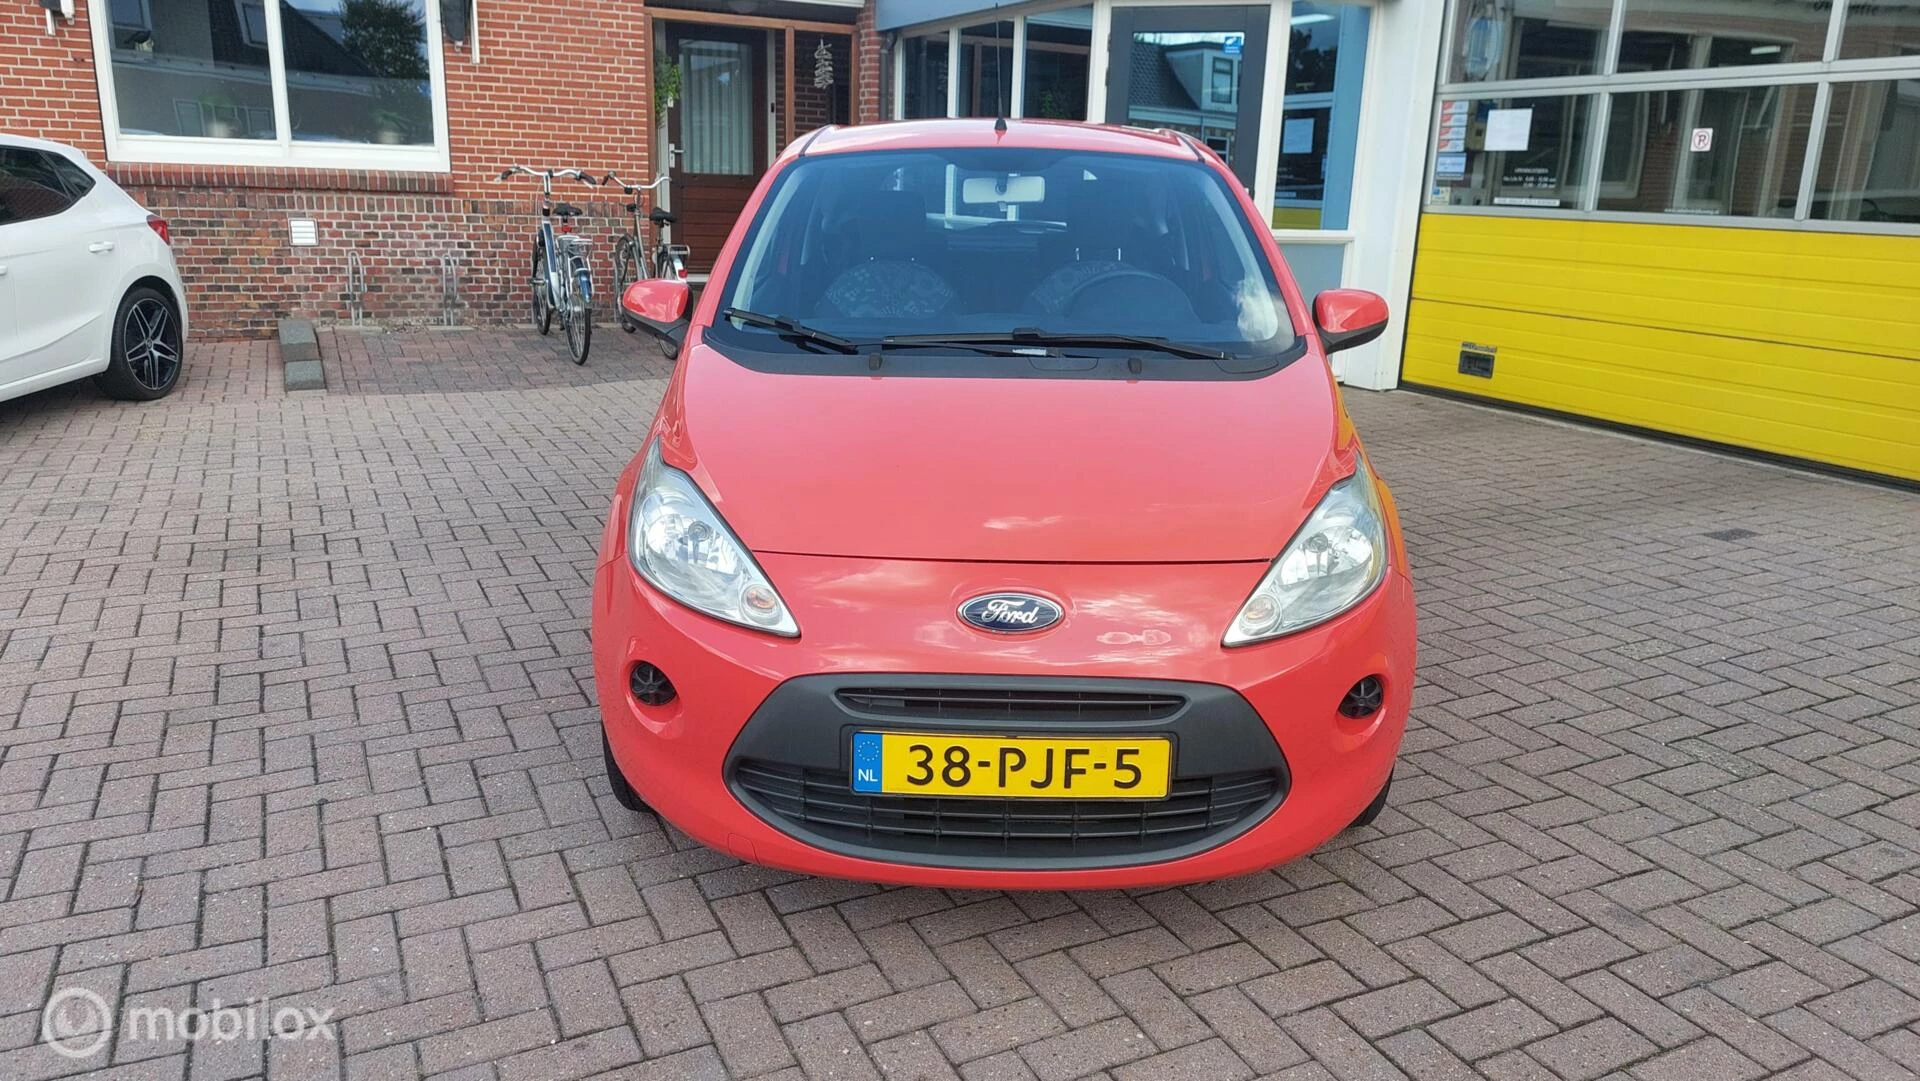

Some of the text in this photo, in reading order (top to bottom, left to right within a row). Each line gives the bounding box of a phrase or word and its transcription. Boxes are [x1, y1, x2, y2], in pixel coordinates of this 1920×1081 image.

[981, 599, 1039, 625] Ford
[857, 769, 879, 783] NL
[906, 744, 1142, 790] 38-PJF-5
